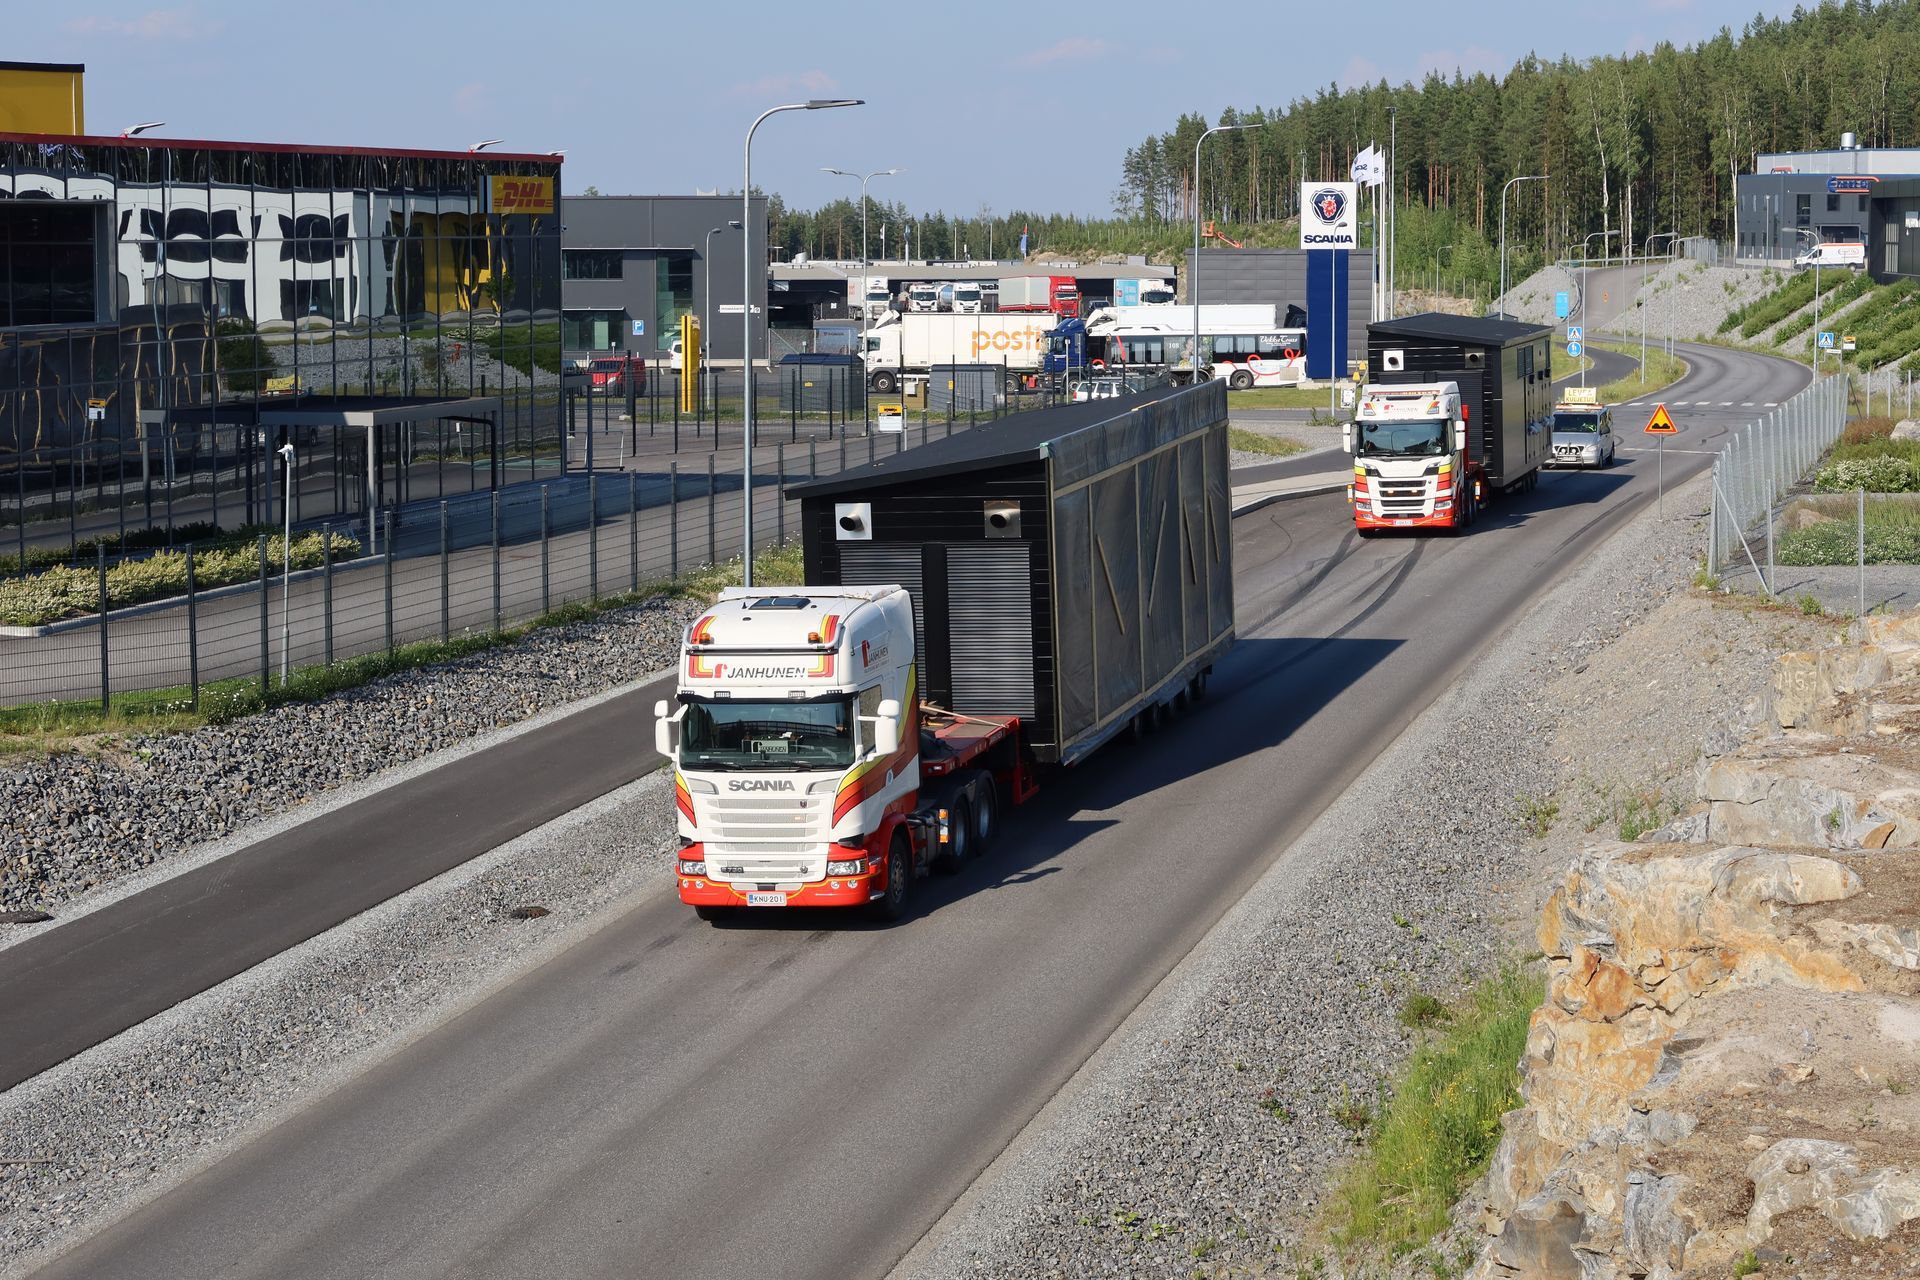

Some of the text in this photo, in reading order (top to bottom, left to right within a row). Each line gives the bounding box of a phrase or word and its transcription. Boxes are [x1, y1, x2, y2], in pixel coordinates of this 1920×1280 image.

[502, 182, 545, 207] DHL
[1304, 235, 1353, 243] SCANIA
[635, 321, 641, 330] P
[972, 325, 1040, 358] posti
[727, 667, 806, 678] JANHUNEN
[728, 779, 796, 792] SCANIA
[754, 895, 783, 903] KNU-201
